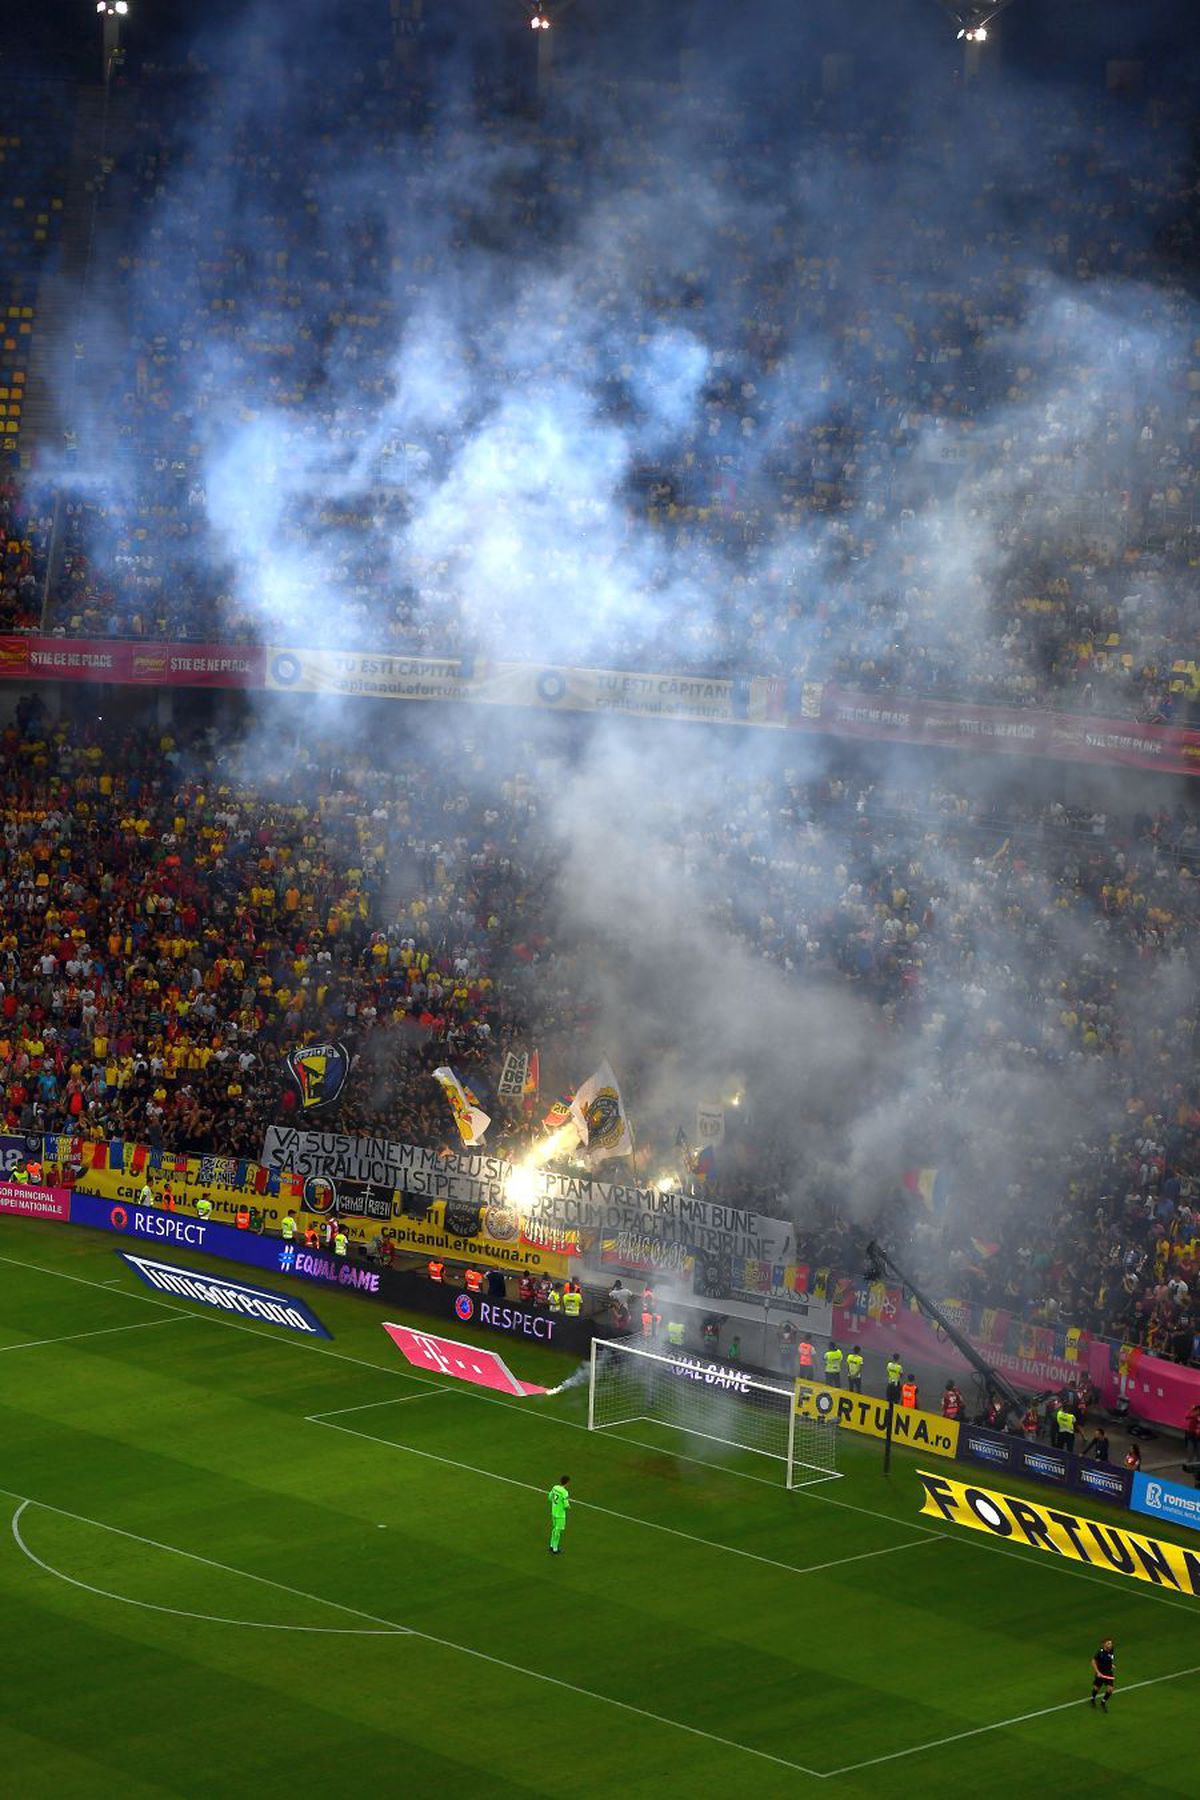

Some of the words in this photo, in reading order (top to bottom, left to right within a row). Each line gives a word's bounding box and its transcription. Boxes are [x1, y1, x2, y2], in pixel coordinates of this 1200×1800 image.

[14, 1189, 55, 1202] PRINCIPAL
[420, 1147, 482, 1178] MEREU
[597, 1184, 674, 1216] VREMURI
[680, 1197, 707, 1225] MAI
[711, 1206, 758, 1236] BUNE
[135, 1212, 207, 1245] RESPECT
[434, 1174, 457, 1199] PE
[531, 1196, 603, 1229] PRECUM
[607, 1206, 620, 1228] O
[623, 1208, 676, 1242] FACEM
[697, 1224, 774, 1264] TRIBUNE
[479, 1301, 557, 1340] RESPECT
